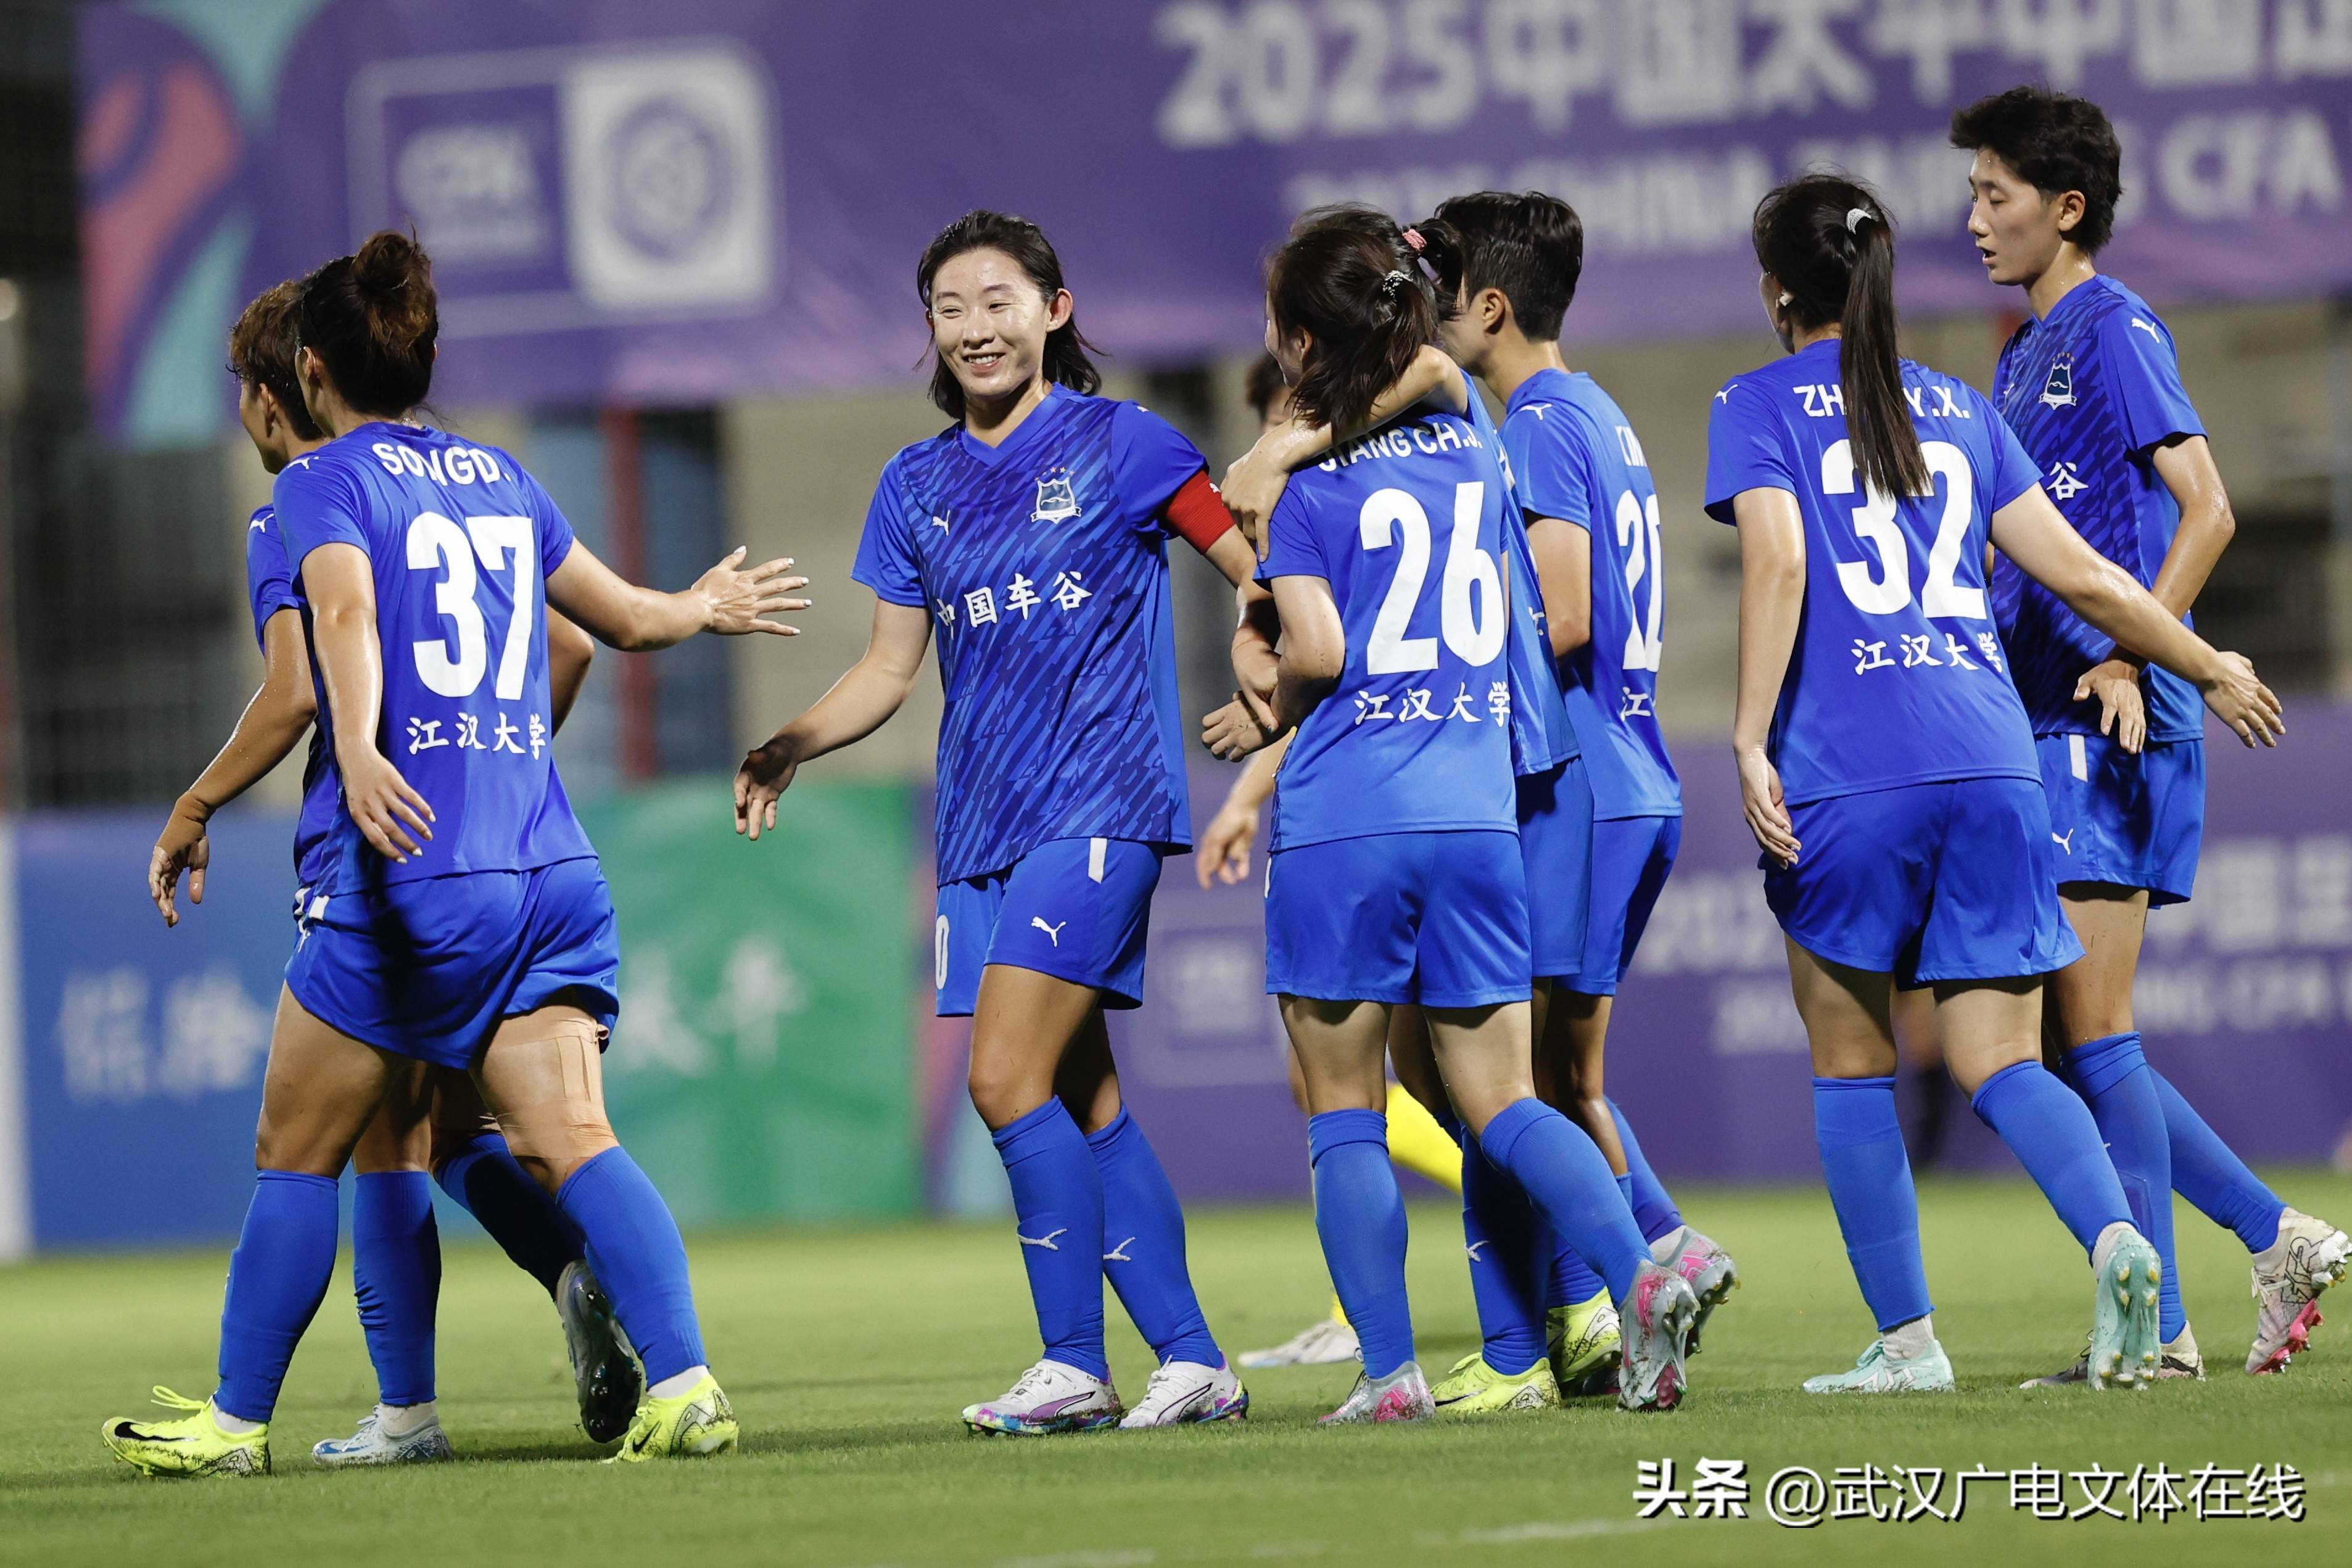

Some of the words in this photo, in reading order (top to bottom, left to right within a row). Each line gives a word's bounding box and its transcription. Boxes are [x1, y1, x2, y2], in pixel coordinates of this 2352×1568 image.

[2047, 461, 2089, 500] 谷
[1821, 439, 1987, 620] 32
[406, 511, 533, 701] 37
[936, 571, 1093, 640] 中国车谷
[1359, 481, 1506, 675] 26
[1851, 631, 2004, 676] 江汉大学
[1353, 680, 1511, 727] 江汉大学
[406, 711, 547, 761] 江汉大学
